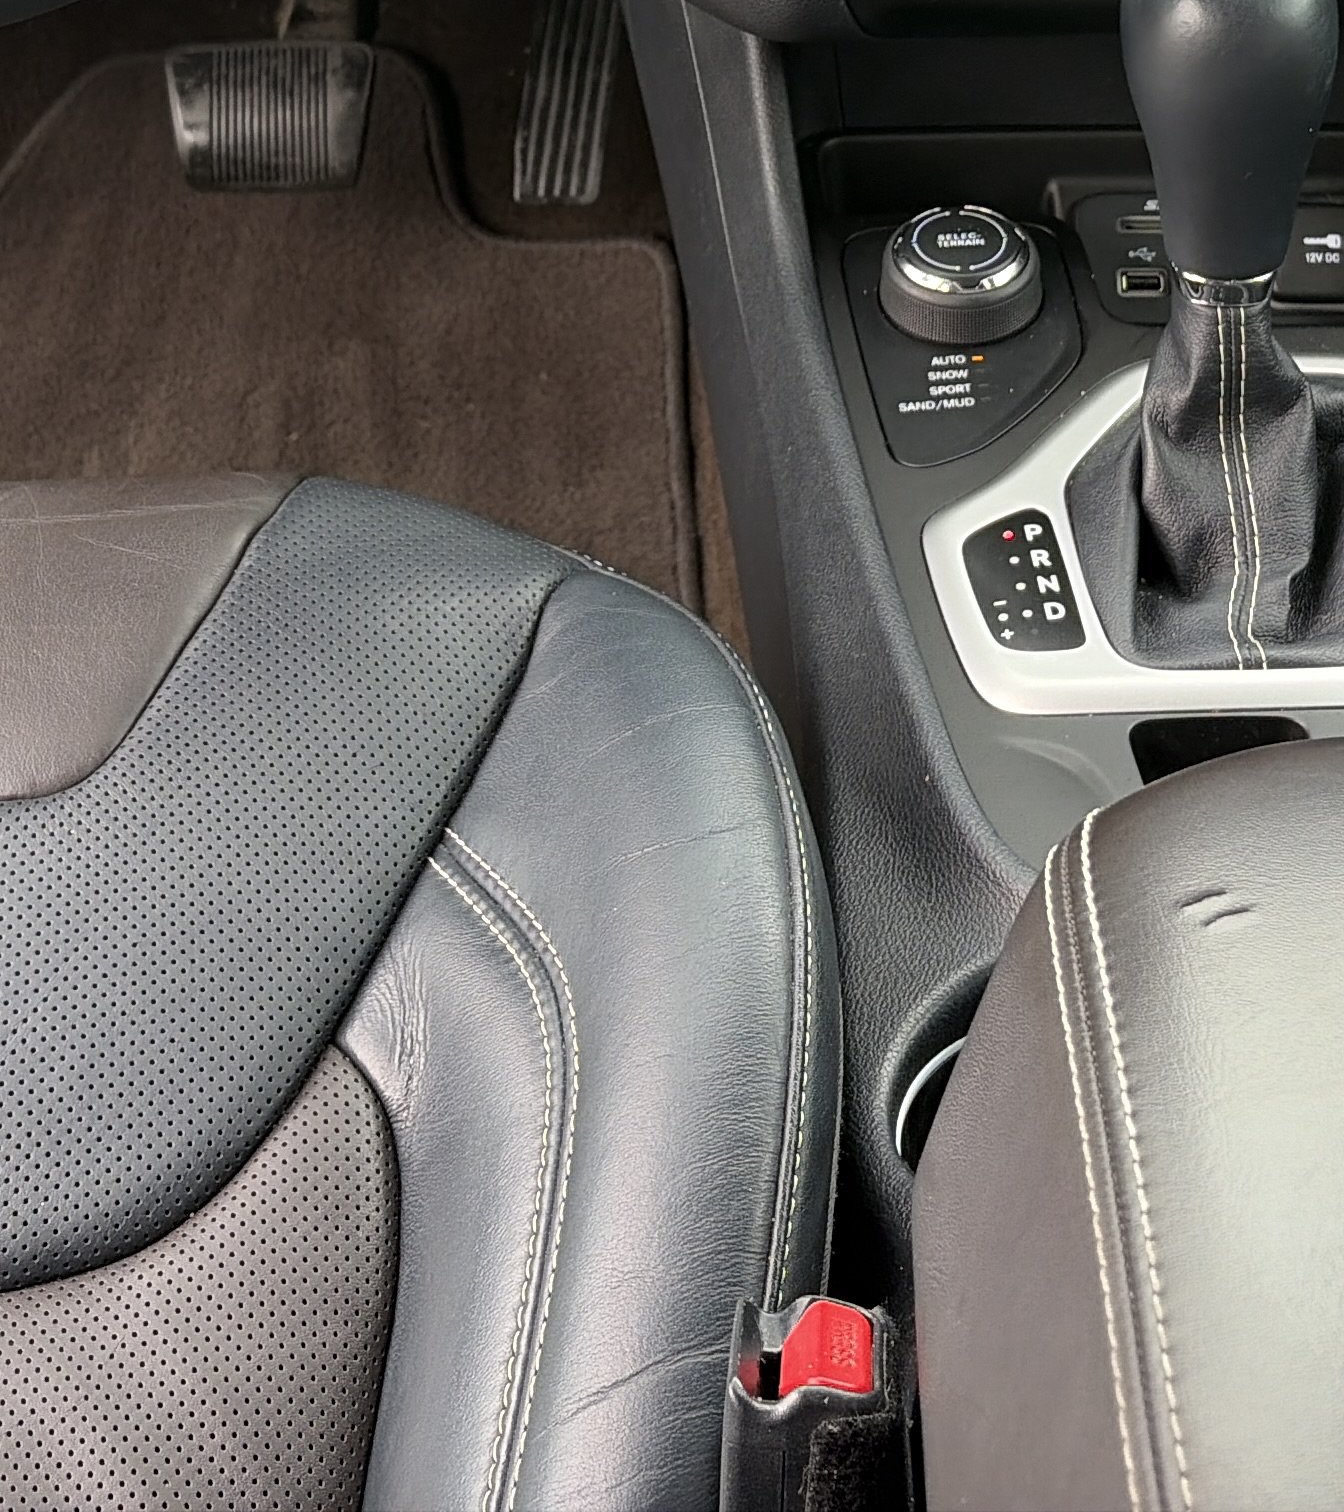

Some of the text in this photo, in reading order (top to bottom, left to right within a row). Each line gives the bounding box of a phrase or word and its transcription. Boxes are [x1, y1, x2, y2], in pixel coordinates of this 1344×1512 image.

[936, 238, 986, 248] TERRAIN
[937, 232, 982, 241] SELEC-
[1305, 251, 1340, 264] 12V DC
[931, 354, 967, 366] AUTO
[927, 368, 969, 381] SNOW
[929, 383, 972, 396] SPORT
[898, 397, 976, 413] SAND/MUD
[1023, 523, 1043, 542] P
[1029, 548, 1053, 568] R
[1036, 574, 1061, 594] N
[1043, 601, 1066, 621] D
